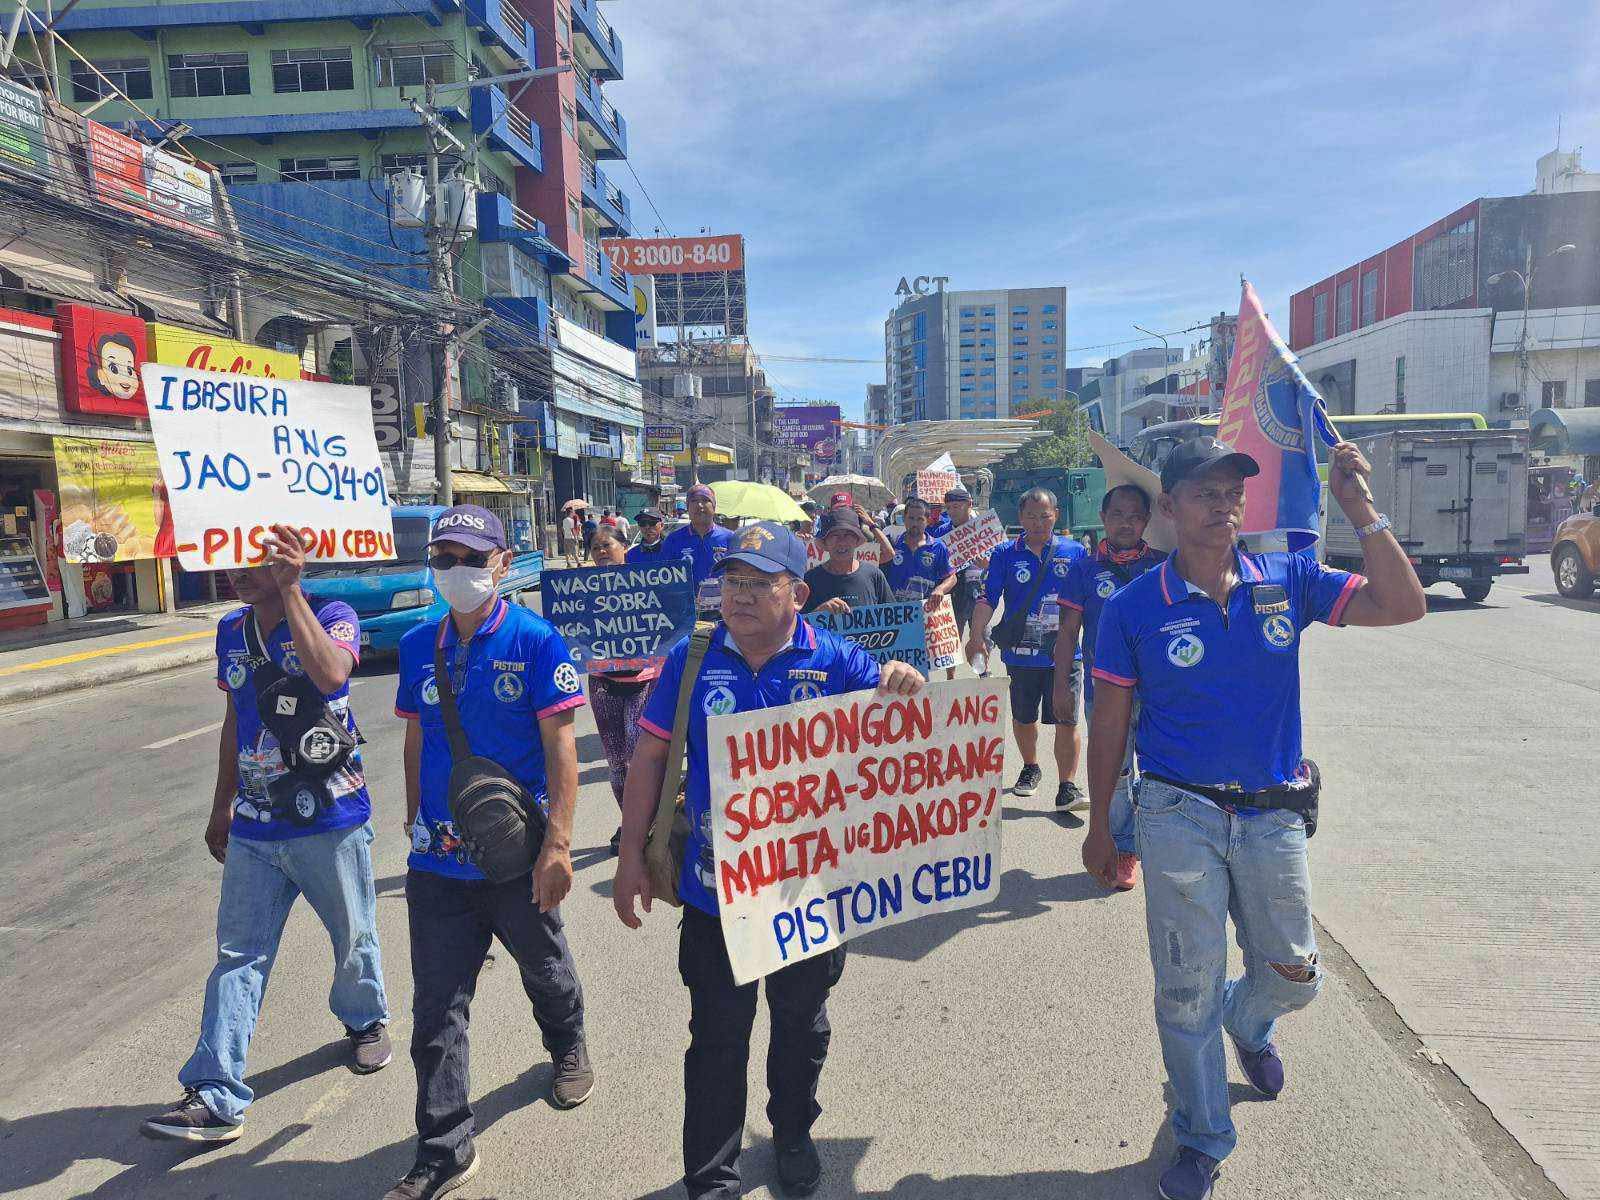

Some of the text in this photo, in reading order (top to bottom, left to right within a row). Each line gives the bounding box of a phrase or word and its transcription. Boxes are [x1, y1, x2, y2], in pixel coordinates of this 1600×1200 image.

[634, 243, 731, 266] 3000-840
[895, 276, 949, 296] ACT
[273, 425, 347, 457] ANG
[919, 487, 950, 495] SYSTE
[438, 513, 486, 530] BOSS
[177, 523, 393, 566] -PISON CEBU
[551, 566, 688, 596] WAGTANGON
[552, 590, 662, 614] ANG SOBRA
[593, 613, 675, 637] MULTA
[843, 605, 919, 630] DRAYBER:
[591, 634, 662, 660] SILOT!
[493, 660, 526, 672] PISTON
[934, 656, 955, 668] CEBU
[788, 669, 829, 683] PISTON
[726, 695, 999, 780] HUNONGON ANG
[724, 736, 1005, 843] SOBRA-SOBRANG
[720, 787, 997, 905] MULTA UG DAKOP!
[772, 853, 992, 961] PISTON CEBU
